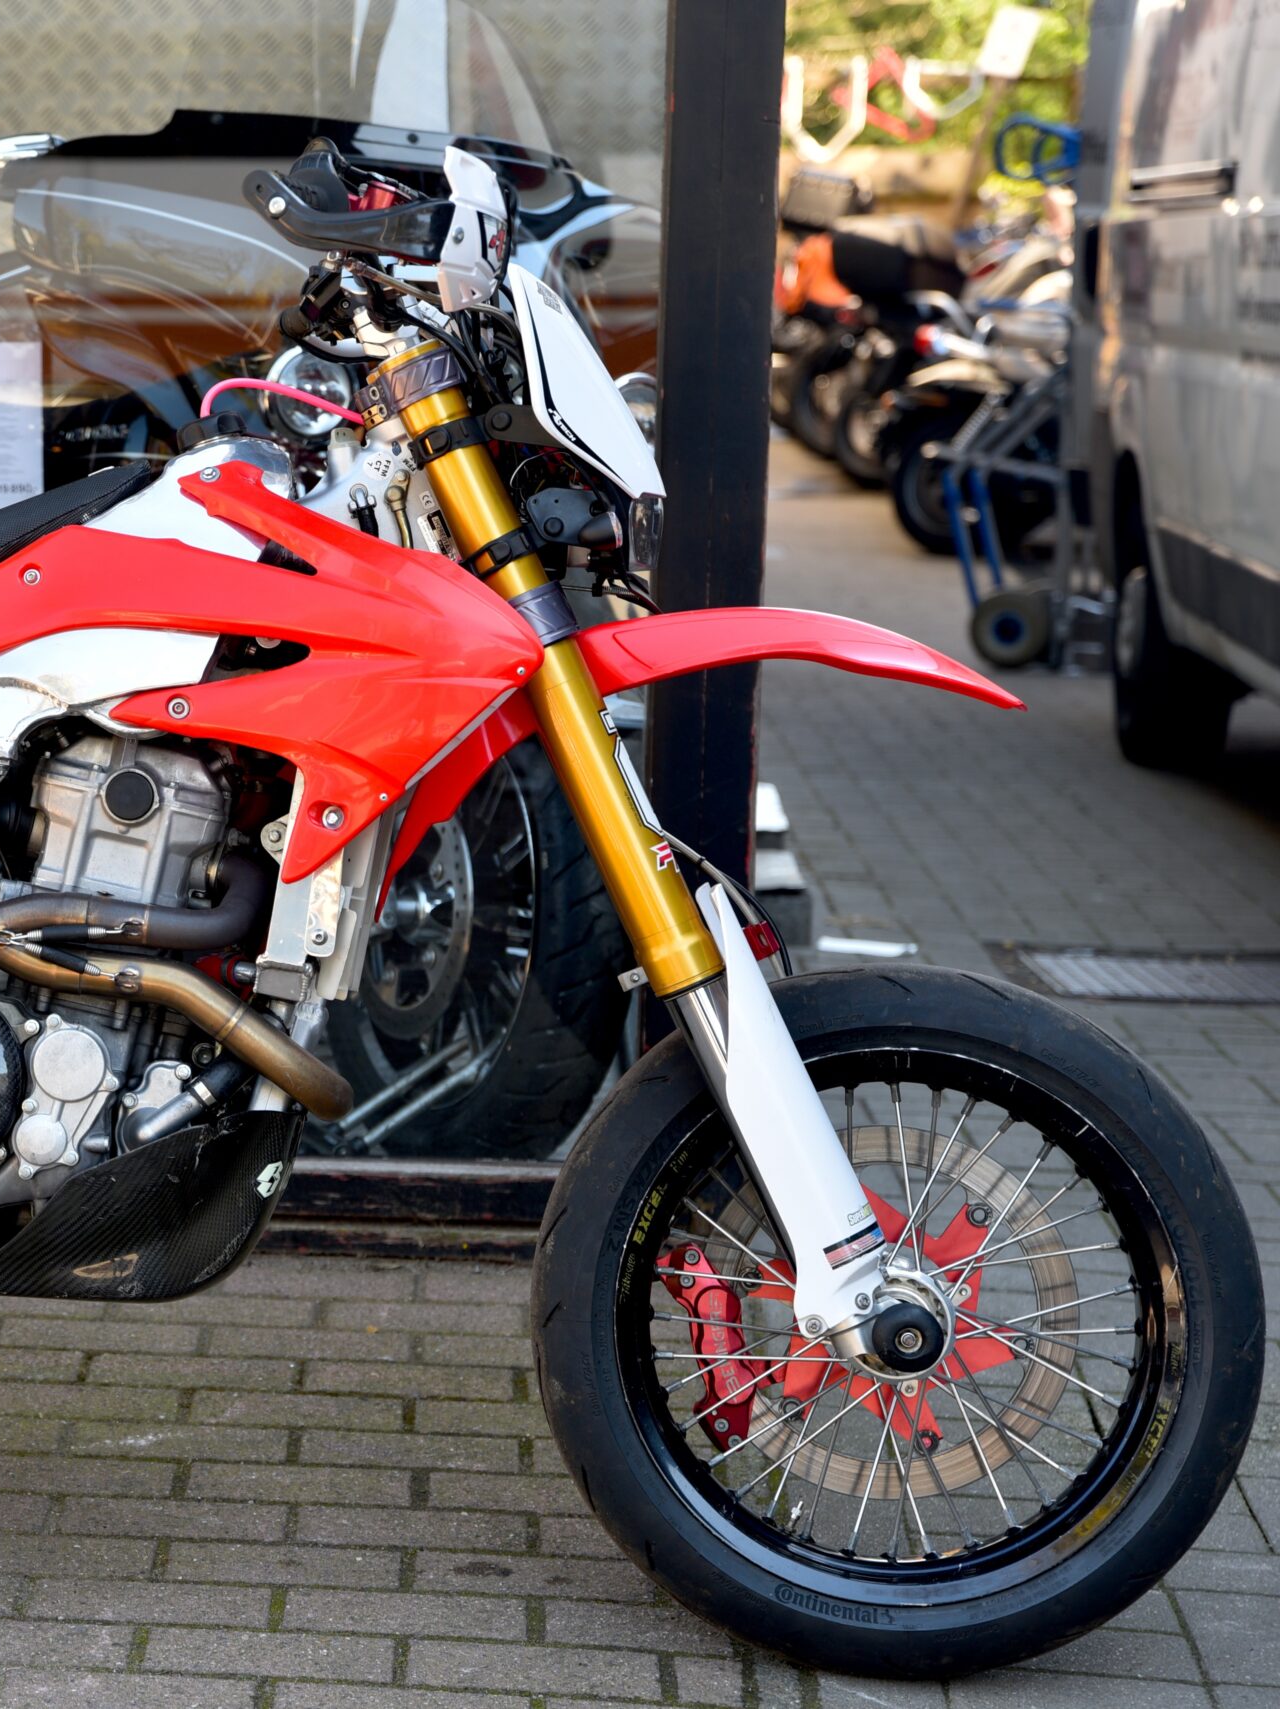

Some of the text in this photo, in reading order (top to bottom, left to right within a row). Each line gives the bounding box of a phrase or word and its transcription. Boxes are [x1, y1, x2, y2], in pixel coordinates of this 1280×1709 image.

[373, 460, 382, 473] CT
[380, 459, 392, 478] FFM
[774, 1583, 879, 1625] Continental
